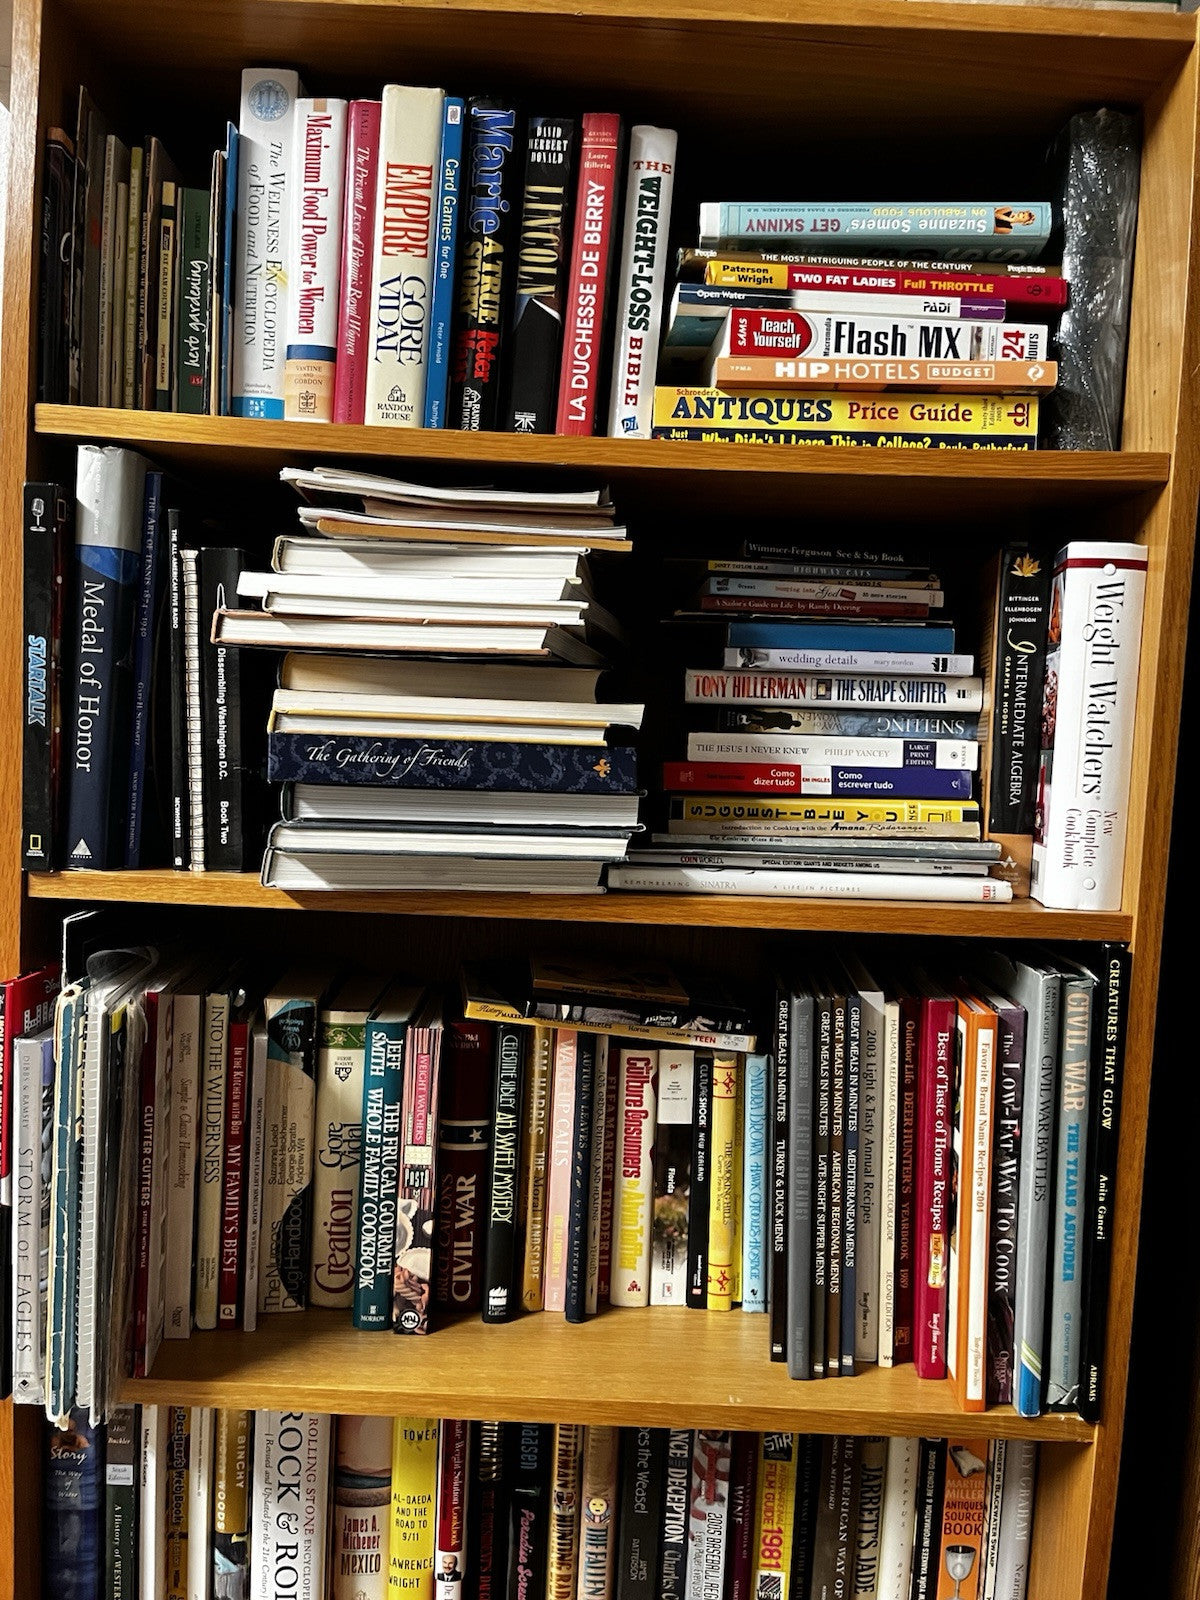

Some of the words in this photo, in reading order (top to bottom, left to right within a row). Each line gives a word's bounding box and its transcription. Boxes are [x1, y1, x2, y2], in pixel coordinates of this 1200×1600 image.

[305, 114, 331, 183] Maximum
[528, 139, 568, 151] HERBERT
[536, 126, 562, 138] DAVID
[248, 165, 261, 177] of
[469, 108, 516, 234] Marie
[633, 160, 671, 175] THE
[248, 184, 264, 226] FOOD
[302, 187, 328, 220] Food
[382, 162, 433, 260] EMPIRE
[517, 185, 564, 298] LINCOLN
[746, 219, 804, 232] SKINNY
[810, 218, 840, 232] GET
[246, 230, 260, 258] and
[301, 225, 328, 266] Power
[628, 176, 662, 332] WEIGHT-LOSS
[302, 271, 316, 284] for
[722, 265, 769, 274] Paterson
[183, 260, 208, 328] gardening
[244, 262, 262, 346] NUTRITION
[298, 286, 324, 334] Women
[374, 272, 402, 366] VIDAL
[398, 276, 427, 366] GORE
[760, 317, 795, 334] Teach
[182, 336, 202, 367] herb
[1002, 330, 1026, 358] 24
[1025, 334, 1039, 362] Hours
[624, 336, 644, 406] BIBLE
[774, 362, 830, 378] HIP
[835, 362, 920, 379] HOTELS
[932, 368, 990, 377] BUDGET
[380, 412, 411, 420] HOUSE
[430, 400, 440, 429] hamlyn
[672, 396, 832, 424] ANTIQUES
[848, 402, 899, 420] Price
[910, 402, 972, 422] Guide
[670, 429, 688, 438] Just
[80, 580, 105, 653] Medal
[28, 634, 47, 727] STARTALK
[79, 662, 102, 690] of
[216, 648, 226, 704] Dissembling
[693, 676, 730, 698] TONY
[732, 676, 807, 700] HILLERMAN
[1003, 656, 1012, 690] GRAPHS
[1006, 628, 1037, 747] INTERMEDIATE
[835, 680, 857, 701] THE
[858, 680, 898, 702] SHAPE
[898, 680, 946, 704] SHIFTER
[76, 694, 100, 772] Honor
[216, 706, 227, 759] Washington
[1000, 702, 1008, 734] MODELS
[218, 760, 228, 780] D.C.
[307, 740, 336, 762] The
[336, 742, 400, 778] Gathering
[392, 744, 429, 779] of
[420, 748, 473, 770] Friends
[771, 770, 795, 778] Como
[838, 771, 863, 780] Como
[1009, 750, 1023, 806] ALGEBRA
[220, 800, 229, 824] Book
[1102, 810, 1118, 836] New
[220, 826, 228, 844] Two
[1080, 810, 1102, 868] Complete
[699, 856, 724, 864] WORLD
[778, 1000, 788, 1031] GREAT
[1106, 960, 1120, 1042] CREATURES
[821, 1012, 830, 1044] GREAT
[1064, 992, 1090, 1050] CIVIL
[370, 1031, 386, 1076] SMITH
[386, 1038, 403, 1070] JEFF
[534, 1038, 549, 1070] SAM
[778, 1033, 787, 1064] MEALS
[820, 1045, 830, 1076] MEALS
[937, 1032, 949, 1062] Best
[1104, 1046, 1116, 1084] THAT
[418, 1054, 429, 1091] WEIGHT
[580, 1052, 591, 1100] AUTUMN
[778, 1066, 786, 1076] IN
[820, 1079, 828, 1090] IN
[936, 1066, 948, 1080] of
[1063, 1060, 1086, 1112] WAR
[384, 1102, 400, 1132] THE
[529, 1078, 547, 1135] HARRIS
[777, 1078, 786, 1122] MINUTES
[819, 1092, 828, 1136] MINUTES
[936, 1082, 948, 1116] Taste
[1102, 1090, 1113, 1130] GLOW
[142, 1106, 154, 1154] CLUTTER
[416, 1094, 427, 1141] WATCHERS
[579, 1104, 589, 1149] LEAVES
[935, 1120, 947, 1134] of
[227, 1144, 241, 1166] MY
[1066, 1124, 1080, 1152] THE
[380, 1136, 398, 1198] FRUGAL
[534, 1151, 545, 1171] THE
[776, 1140, 786, 1177] TURKEY
[934, 1138, 946, 1176] Home
[18, 1148, 33, 1227] STORM
[141, 1158, 151, 1206] CUTTERS
[532, 1176, 544, 1212] Moral
[776, 1178, 784, 1187] &
[817, 1154, 827, 1212] LATE-NIGHT
[832, 1150, 842, 1202] AMERICAN
[1064, 1158, 1078, 1207] YEARS
[1098, 1174, 1108, 1202] Anita
[224, 1171, 240, 1234] FAMILY'S
[455, 1174, 476, 1229] WAR
[775, 1190, 784, 1216] DUCK
[930, 1180, 946, 1230] Recipes
[376, 1200, 396, 1276] GOURMET
[774, 1218, 784, 1252] MENUS
[816, 1214, 826, 1249] SUPPER
[830, 1206, 840, 1256] REGIONAL
[1096, 1206, 1106, 1240] Ganeri
[18, 1240, 30, 1260] OF
[222, 1238, 238, 1274] BEST
[314, 1189, 355, 1294] Creation
[530, 1216, 542, 1280] LANDSCAPE
[1062, 1212, 1076, 1282] ASUNDER
[451, 1230, 474, 1302] CIVIL
[815, 1251, 824, 1286] MENUS
[830, 1258, 840, 1294] MENUS
[17, 1274, 32, 1352] EAGLES
[1088, 1365, 1098, 1402] ABRAMS
[50, 1446, 88, 1466] Story
[236, 1436, 246, 1488] BINCHY
[276, 1412, 304, 1504] ROCK
[217, 1480, 225, 1530] WOODS
[396, 1507, 411, 1516] AND
[415, 1506, 428, 1516] THE
[396, 1519, 412, 1528] ROAD
[418, 1518, 428, 1528] TO
[664, 1467, 688, 1544] DECEPTION
[945, 1500, 984, 1510] ANTIQUES
[1015, 1476, 1032, 1541] GRAHAM
[276, 1513, 298, 1534] &
[402, 1532, 419, 1541] 9/11
[707, 1512, 722, 1536] 2005
[944, 1522, 982, 1536] BOOK
[662, 1550, 681, 1590] Charles
[704, 1538, 722, 1580] BASEBALL
